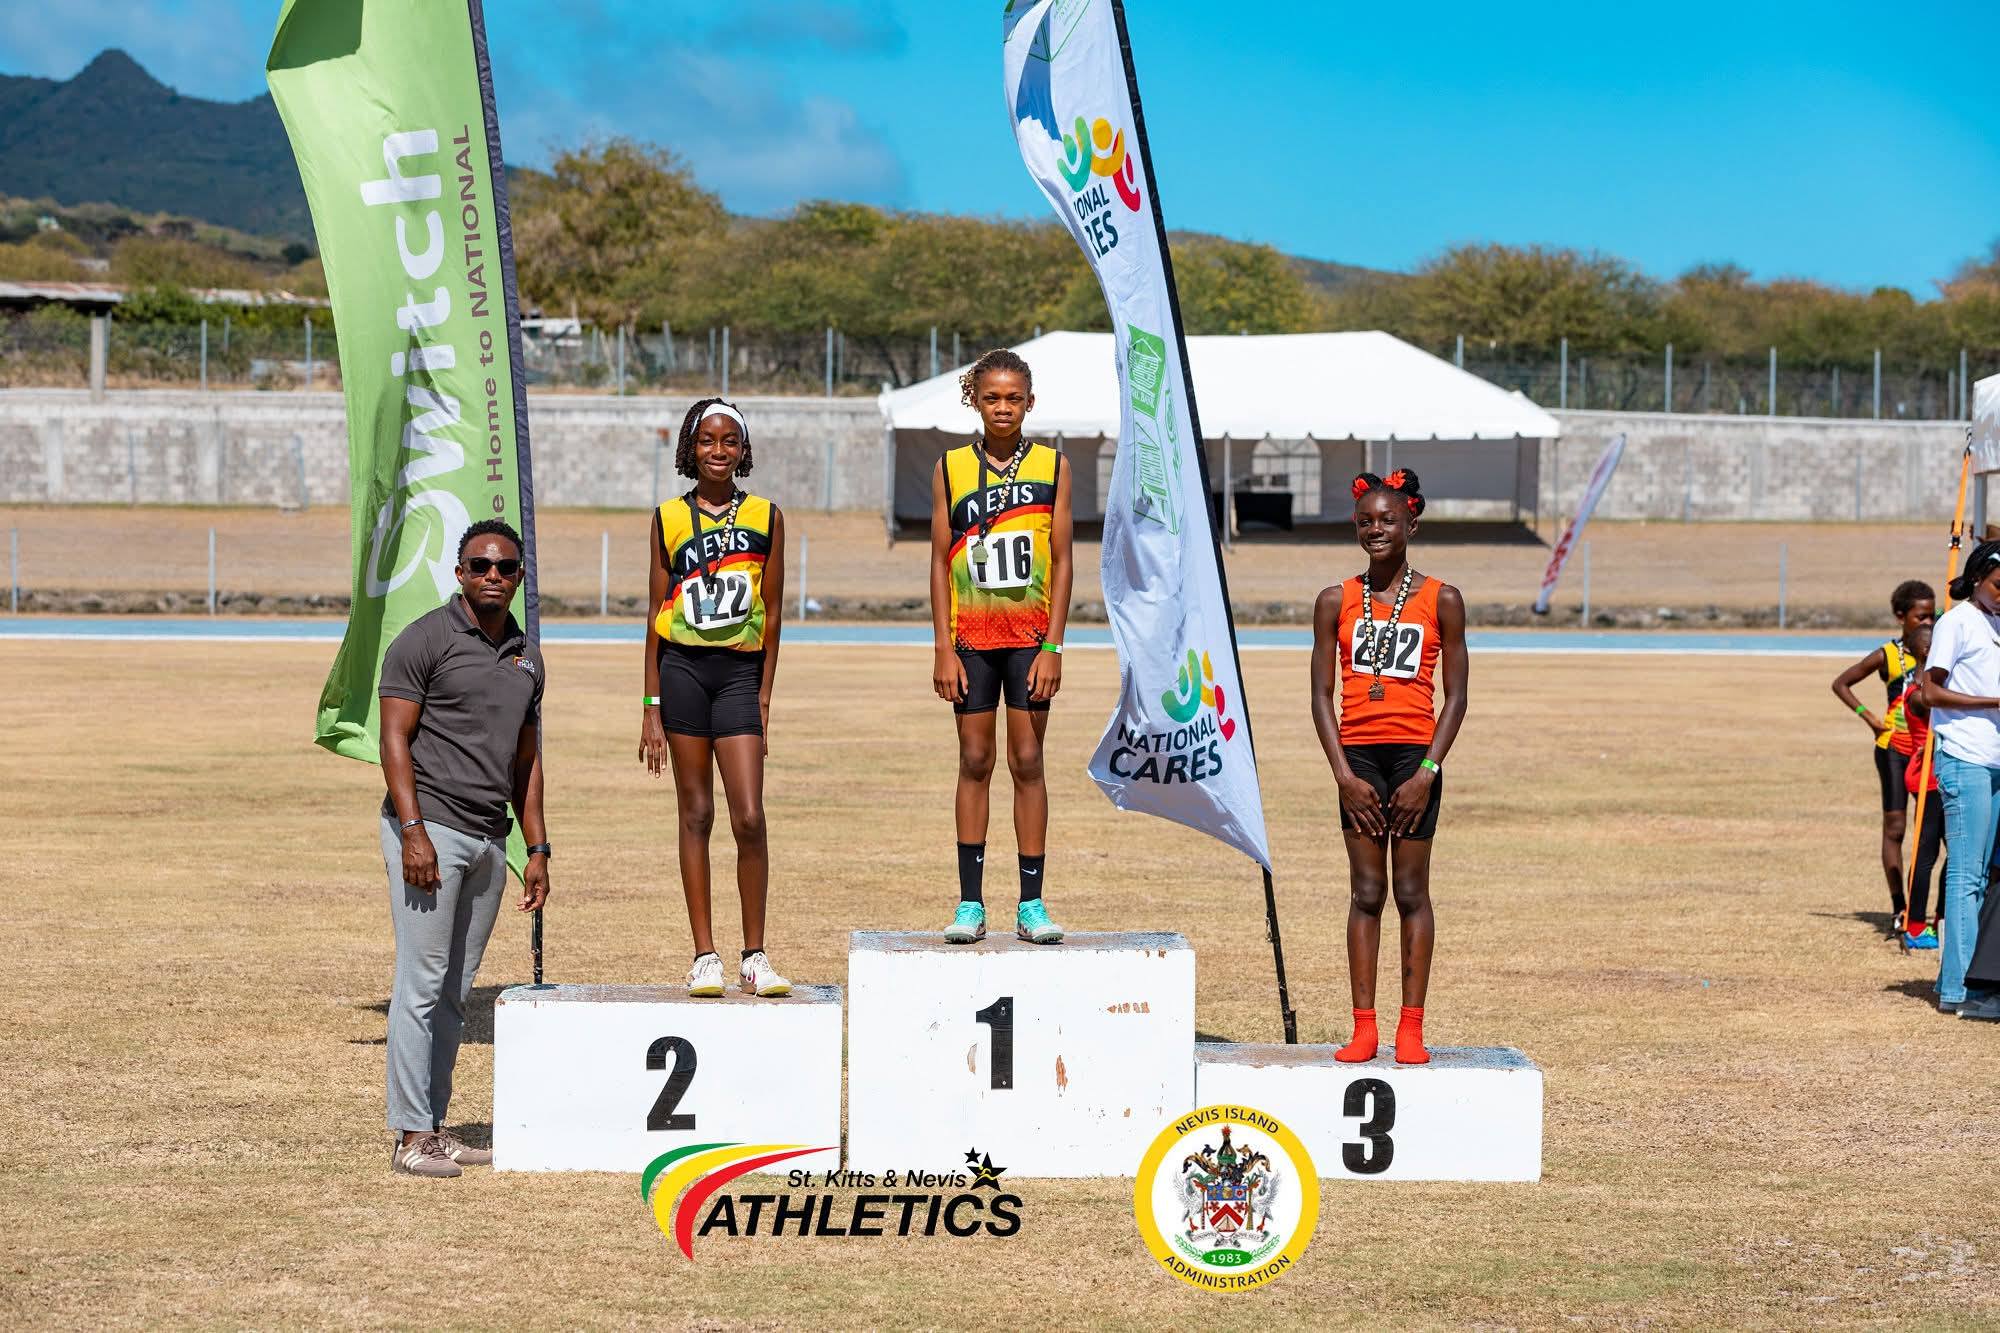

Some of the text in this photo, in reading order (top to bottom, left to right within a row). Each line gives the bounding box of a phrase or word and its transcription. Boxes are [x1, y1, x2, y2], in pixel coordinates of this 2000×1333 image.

[453, 124, 490, 318] NATIONAL
[360, 128, 473, 602] Switch
[480, 330, 494, 367] to
[484, 376, 503, 482] Home
[967, 484, 1034, 523] NEIS
[686, 574, 749, 625] 122
[1354, 623, 1421, 673] 202
[1109, 740, 1223, 785] CARES
[1117, 713, 1216, 753] NATIONAL
[976, 996, 1014, 1090] 1
[646, 1035, 698, 1131] 2
[1342, 1078, 1396, 1175] 3
